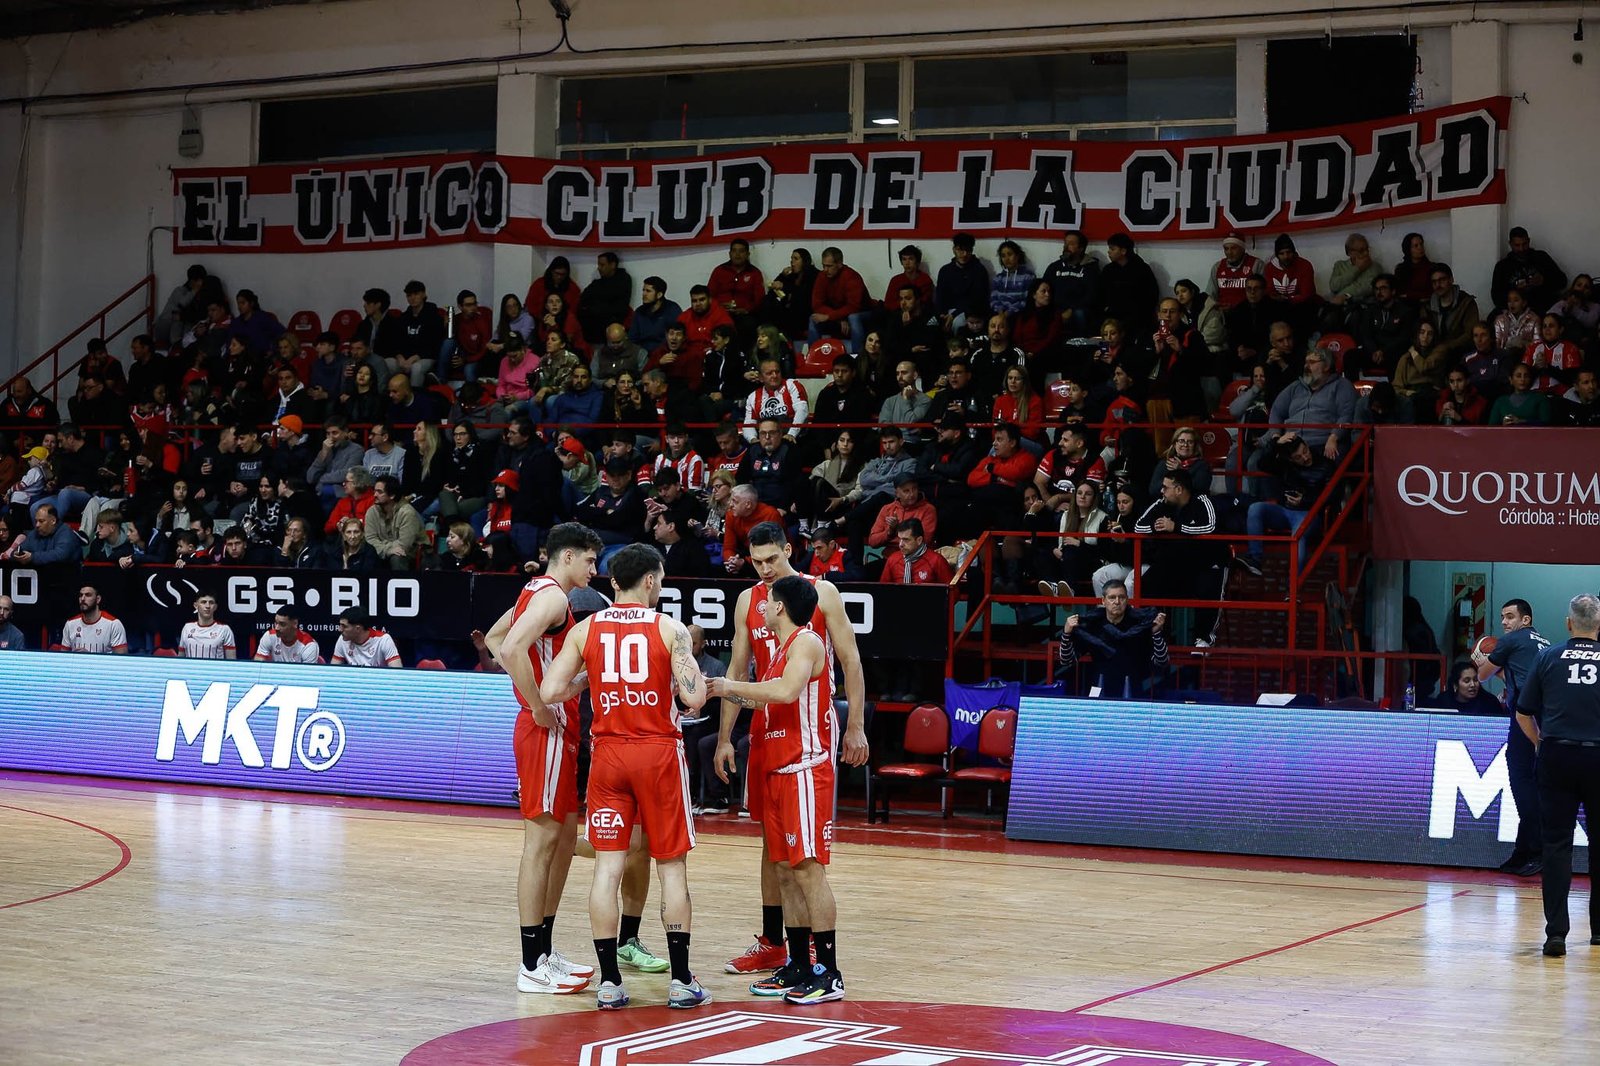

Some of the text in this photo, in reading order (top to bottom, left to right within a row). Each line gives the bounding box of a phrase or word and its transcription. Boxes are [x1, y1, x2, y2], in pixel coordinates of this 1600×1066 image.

[178, 108, 1497, 246] EL ÚNICO CLUB DE LA CIUDAD
[1397, 464, 1600, 516] QUORUM
[1499, 507, 1555, 526] Córdoba
[604, 610, 646, 620] POMOLI
[599, 632, 649, 684] 10
[1567, 663, 1598, 685] 13
[591, 812, 625, 828] GEA
